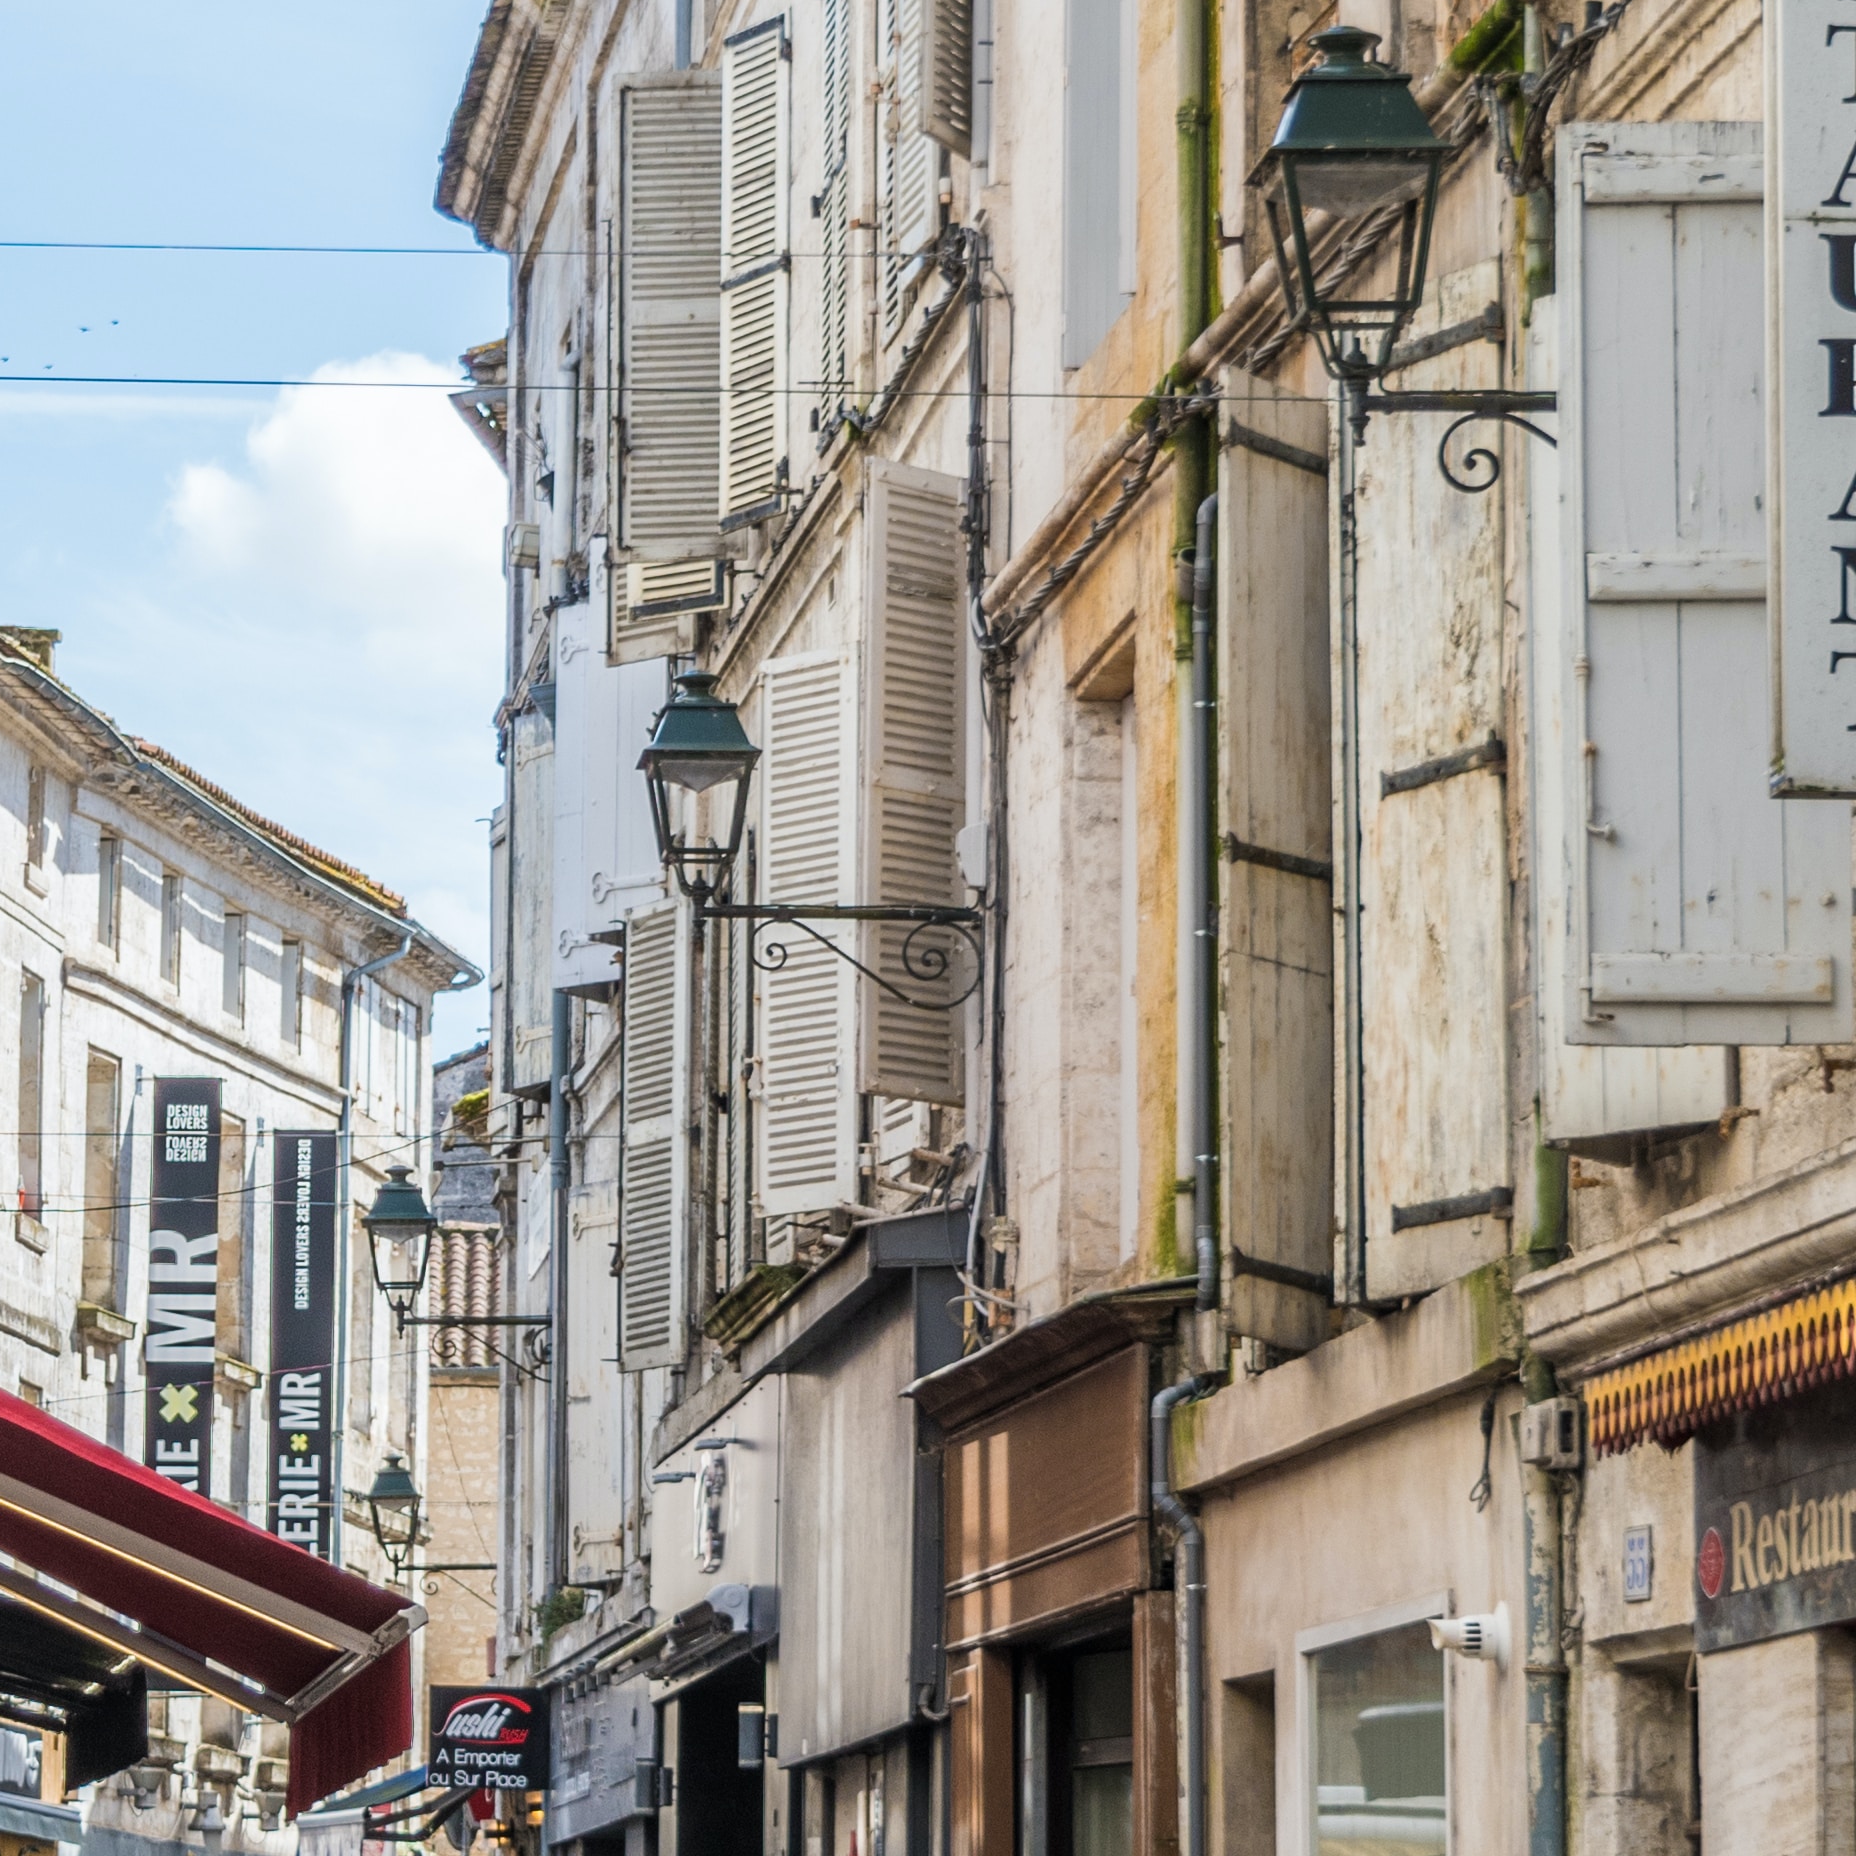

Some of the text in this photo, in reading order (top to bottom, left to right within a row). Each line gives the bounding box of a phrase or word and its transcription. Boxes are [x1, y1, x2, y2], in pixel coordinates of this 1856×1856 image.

[167, 1104, 208, 1117] DESIGN
[166, 1117, 208, 1130] LOVERS
[294, 1224, 310, 1310] DESIGN LOVERS
[146, 1229, 218, 1363] MR
[278, 1371, 322, 1431] MR
[436, 1748, 521, 1767] A Emporter
[429, 1769, 527, 1787] ou Sur Place
